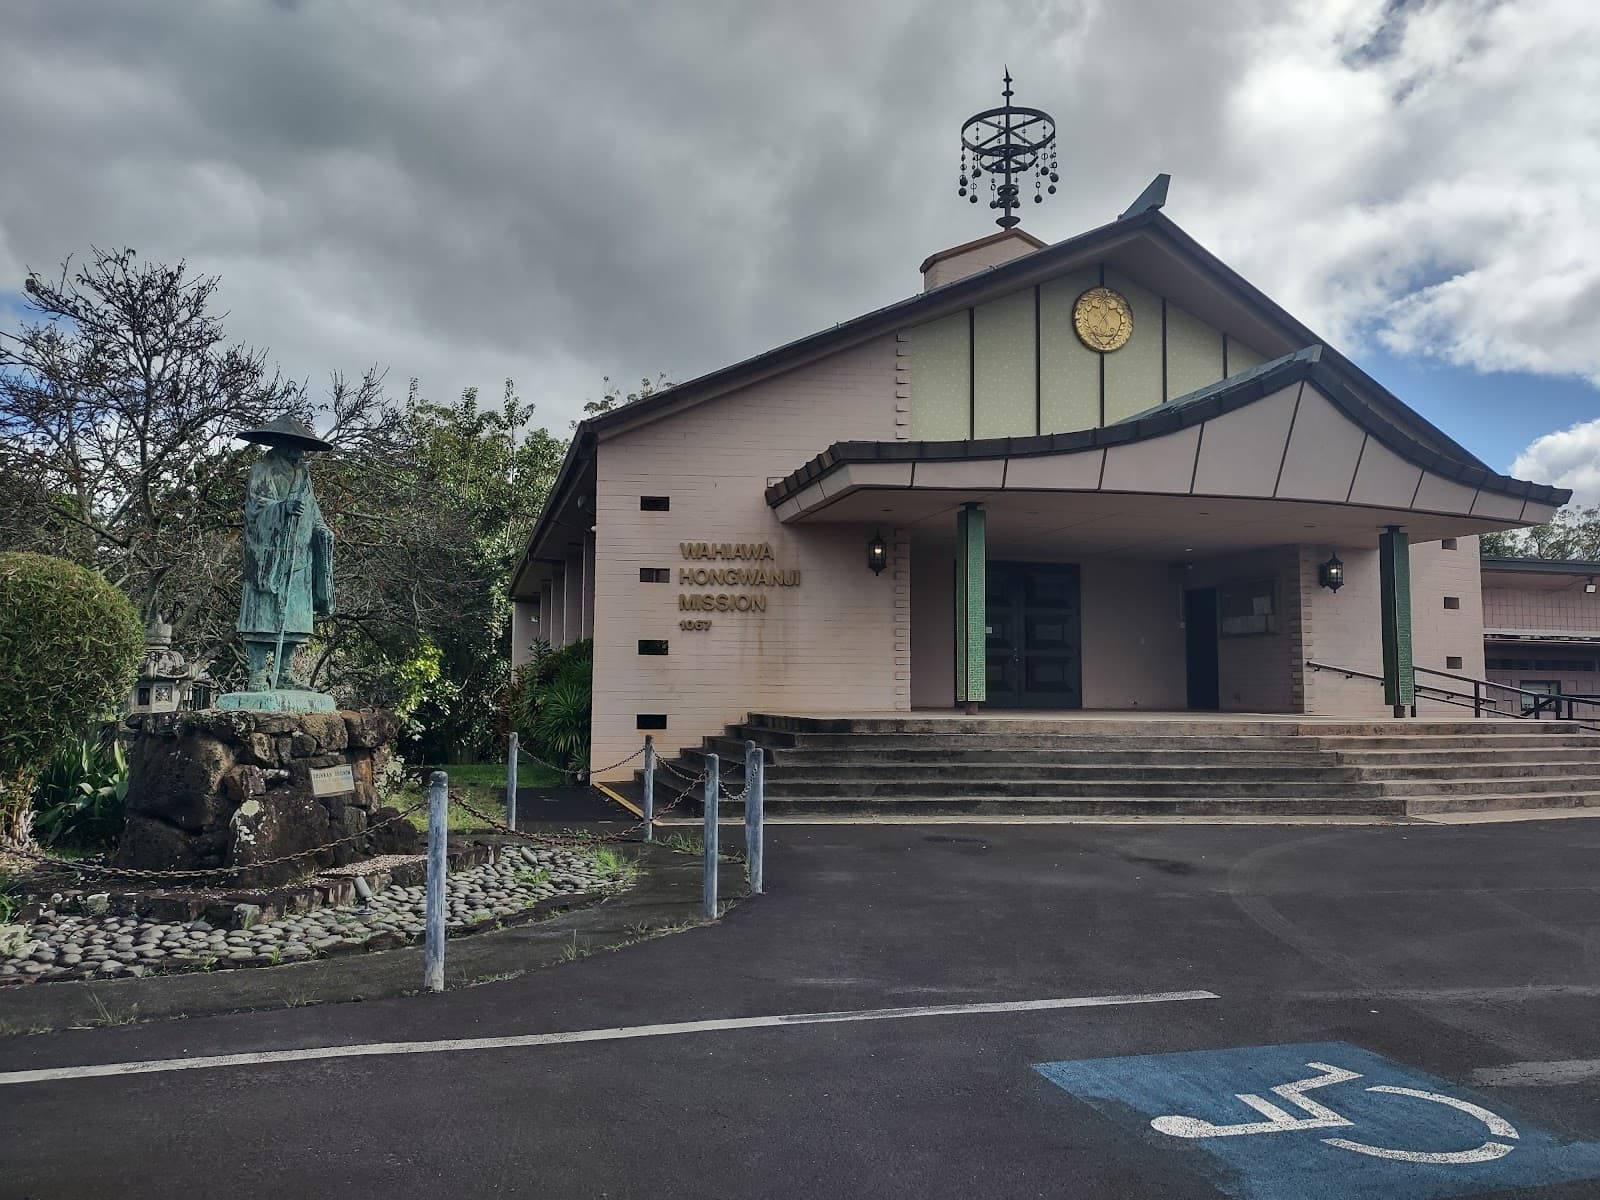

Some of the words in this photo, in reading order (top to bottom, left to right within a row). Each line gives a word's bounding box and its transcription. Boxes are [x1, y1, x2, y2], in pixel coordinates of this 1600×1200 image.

[679, 542, 774, 560] WAHIAWA
[679, 568, 801, 587] HONGWANJI
[678, 593, 767, 613] MISSION
